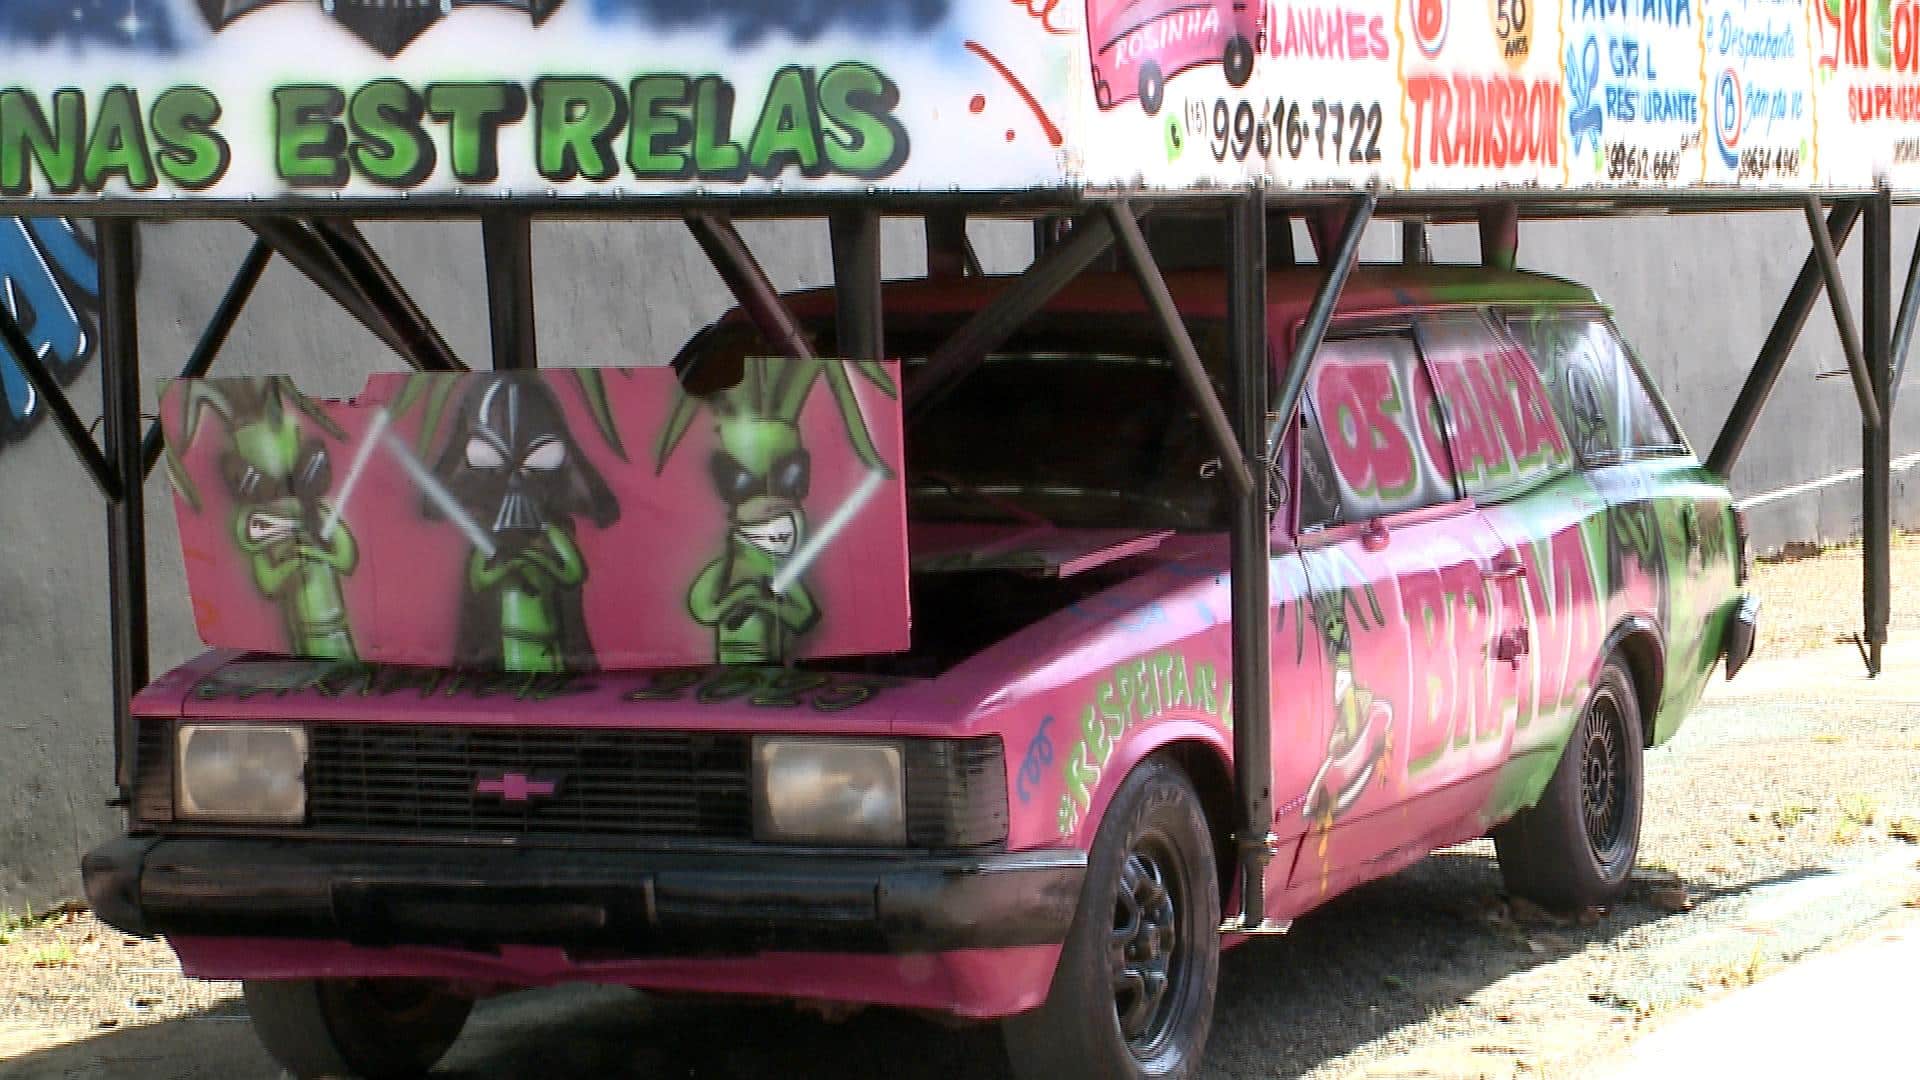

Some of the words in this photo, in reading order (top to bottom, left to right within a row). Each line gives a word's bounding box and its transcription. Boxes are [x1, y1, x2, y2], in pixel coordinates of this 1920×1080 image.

[1268, 9, 1390, 60] LANCHES
[0, 86, 231, 193] NAS
[272, 62, 911, 187] ESTRELAS
[1406, 72, 1560, 172] TRANSBON
[1314, 358, 1423, 500] OS
